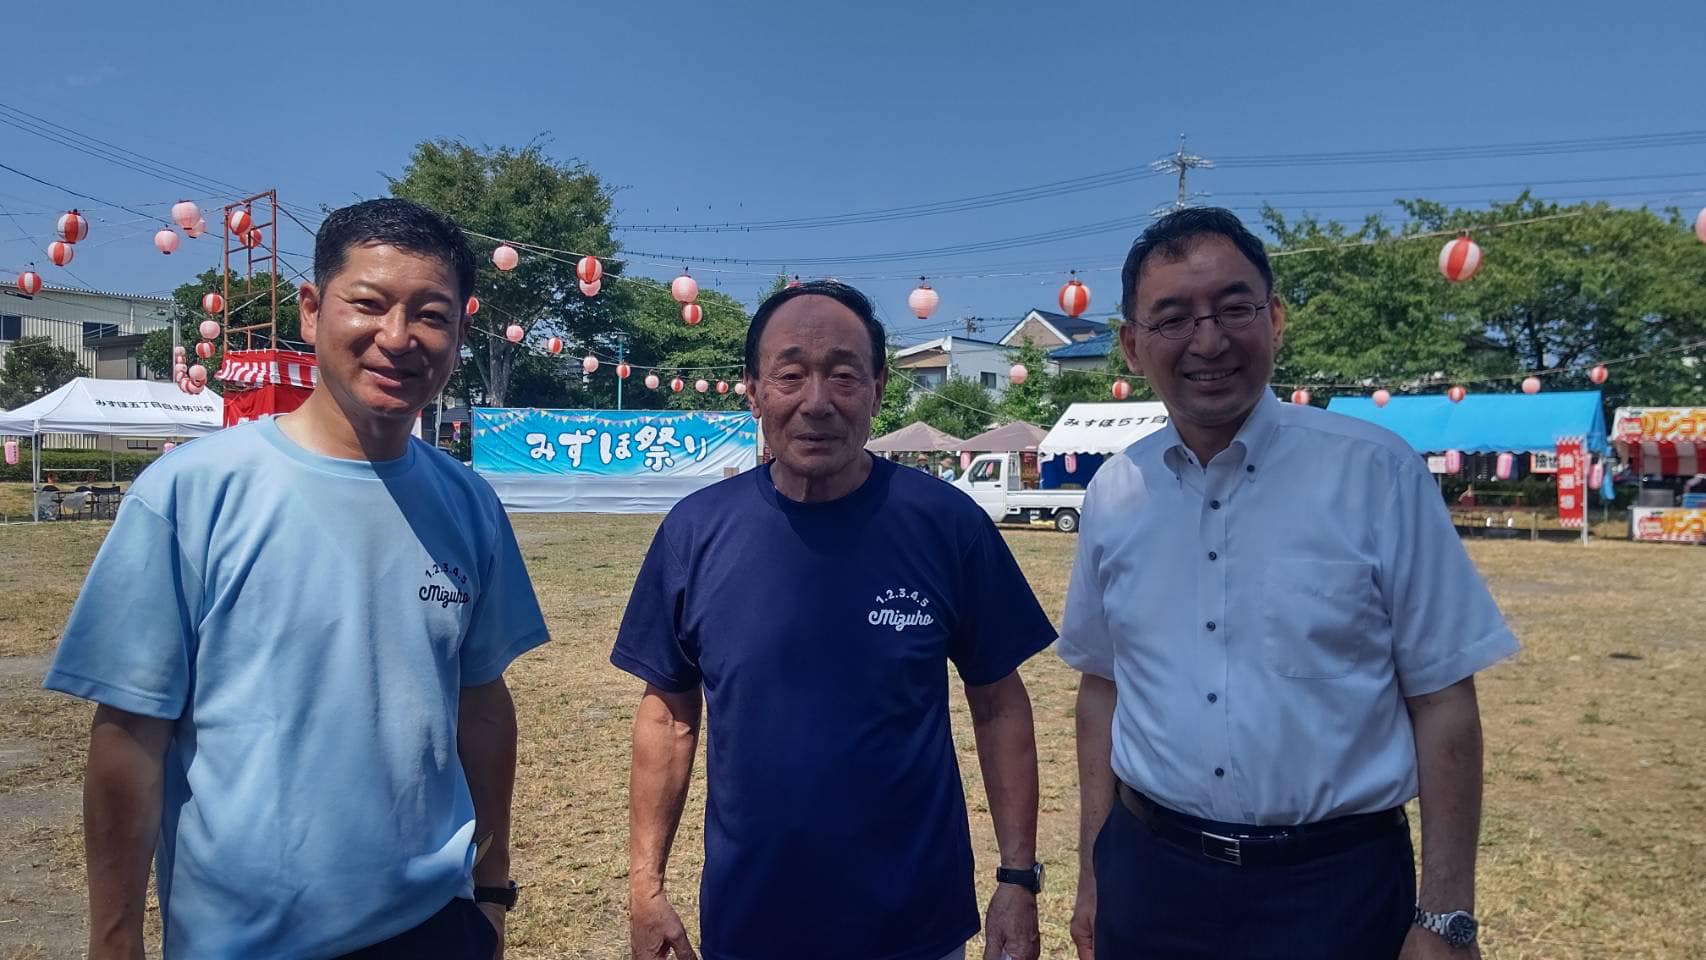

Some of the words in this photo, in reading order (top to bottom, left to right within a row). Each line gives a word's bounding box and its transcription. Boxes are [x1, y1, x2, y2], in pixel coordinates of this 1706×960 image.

[525, 425, 707, 472] みずほ祭り
[418, 584, 471, 609] Mizuho
[868, 608, 934, 632] Mizuho
